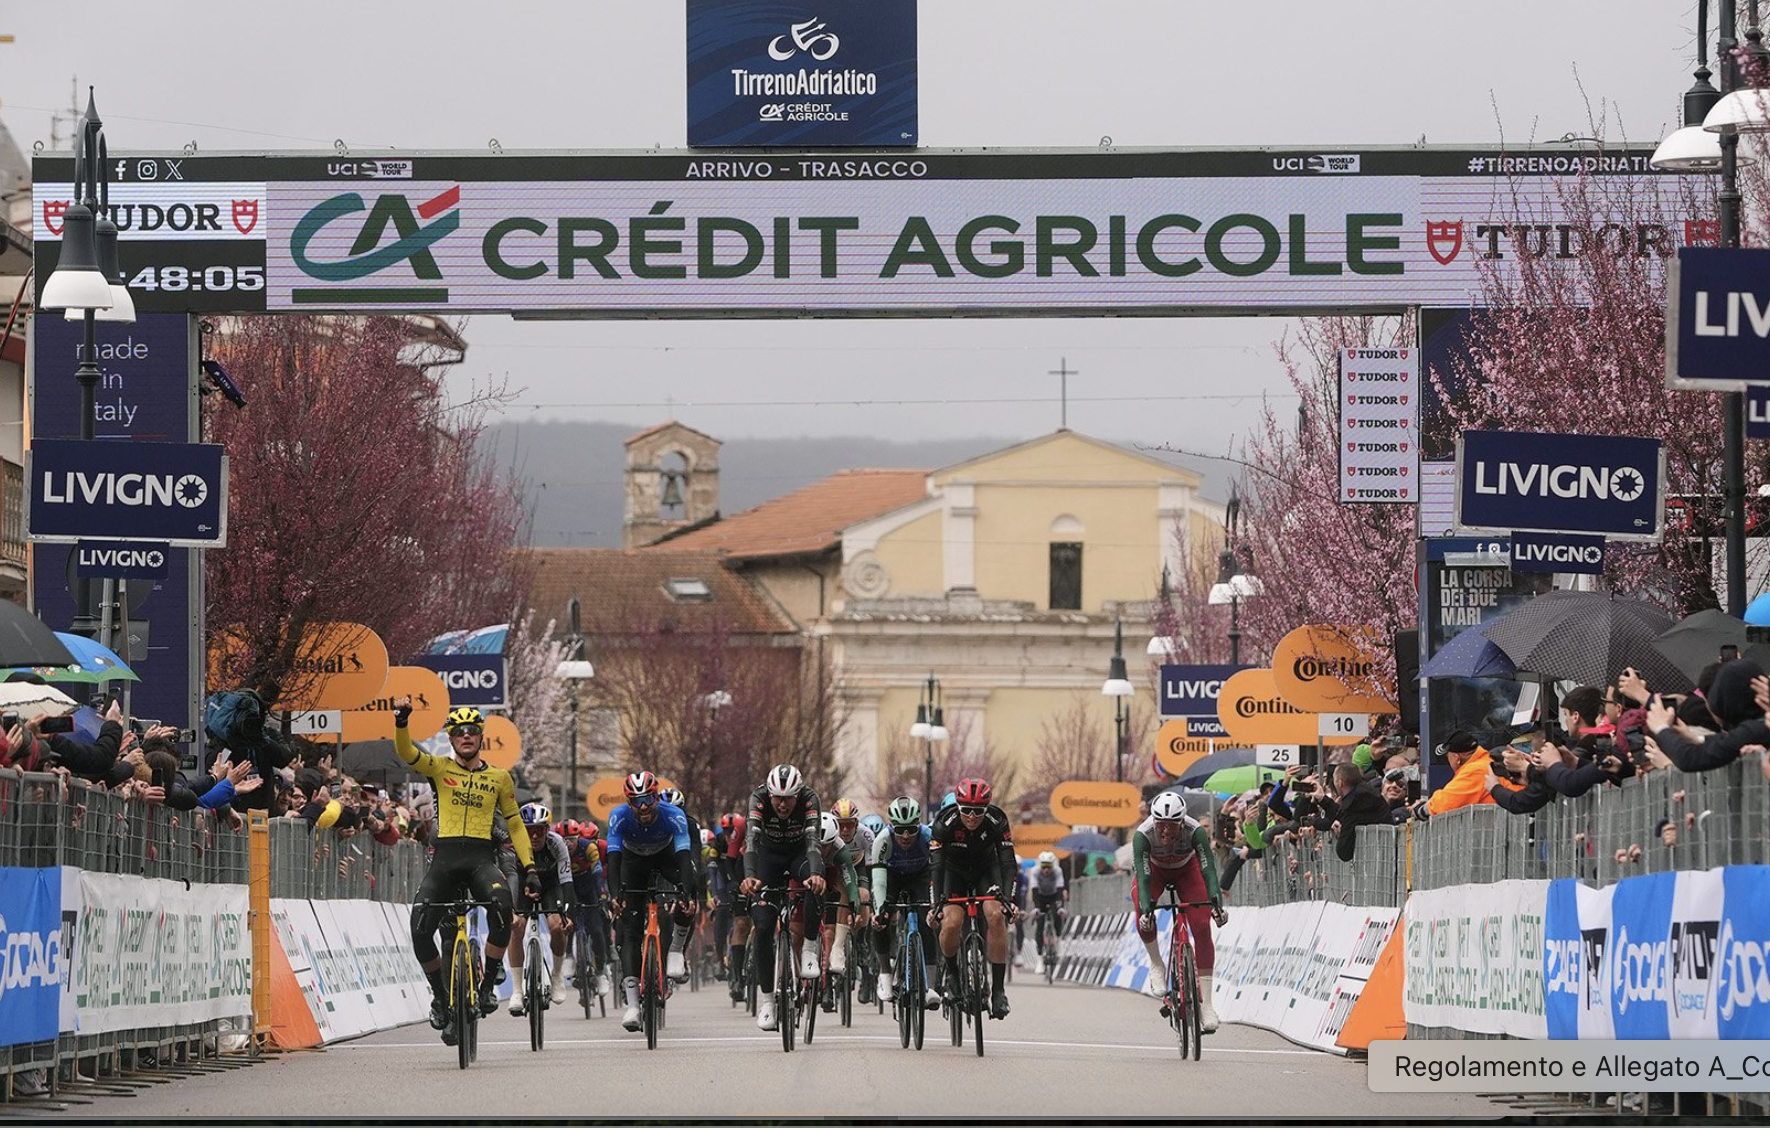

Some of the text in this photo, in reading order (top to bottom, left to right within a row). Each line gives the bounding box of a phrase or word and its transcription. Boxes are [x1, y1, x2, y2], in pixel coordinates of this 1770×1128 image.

[731, 68, 877, 96] TirrenoAdriatico
[787, 103, 832, 112] CRÉDIT
[787, 112, 849, 122] AGRICOLE
[327, 163, 358, 176] UCI
[685, 162, 772, 178] ARRIVO
[798, 161, 928, 178] TRASACCO
[1273, 158, 1304, 171] UCI
[1468, 156, 1665, 173] #TIRRENOADRIATI
[108, 203, 223, 232] UDOR
[482, 200, 1405, 280] CRÉDIT AGRICOLE
[119, 266, 265, 292] 48:05
[1358, 350, 1398, 359] TUDOR
[102, 367, 123, 389] in
[1358, 373, 1398, 381] TUDOR
[1358, 396, 1398, 405] TUDOR
[94, 396, 138, 428] taly
[1358, 419, 1398, 428] TUDOR
[1358, 443, 1398, 452] TUDOR
[1358, 467, 1398, 476] TUDOR
[43, 471, 208, 508] LIVIGNO
[1476, 461, 1645, 502] LIVIGNO
[1358, 489, 1398, 498] TUDOR
[79, 549, 164, 568] LIVIGNO
[1514, 543, 1602, 564] LIVIGNO
[1440, 570, 1513, 588] LA CORSA
[1469, 588, 1498, 607] DUE
[1441, 607, 1482, 626] MARI
[437, 669, 498, 689] IGNO
[1167, 680, 1224, 699] LIVIG
[308, 714, 327, 729] 10
[1188, 722, 1224, 733] LIVIGN
[1334, 718, 1354, 732] 10
[1271, 749, 1290, 762] 25
[452, 789, 484, 801] lease
[462, 780, 495, 794] VISMA
